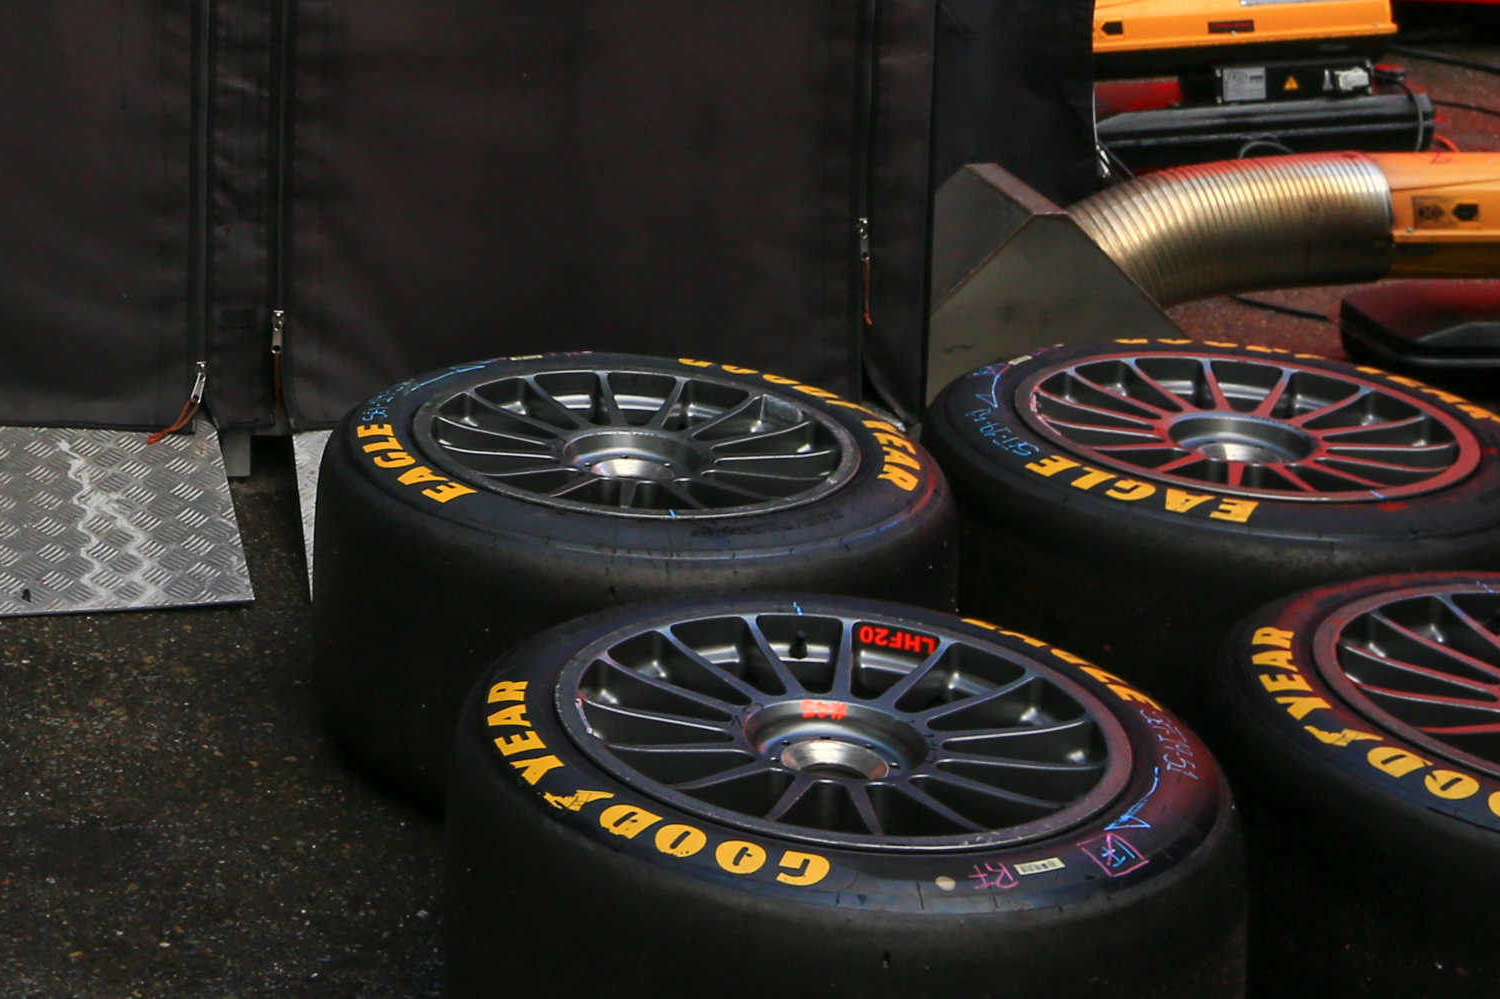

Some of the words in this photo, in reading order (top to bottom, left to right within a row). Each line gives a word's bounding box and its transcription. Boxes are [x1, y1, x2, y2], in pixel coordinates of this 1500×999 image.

[356, 423, 479, 504] EAGLE
[1024, 445, 1260, 523] EAGLE
[859, 625, 938, 655] LHF20
